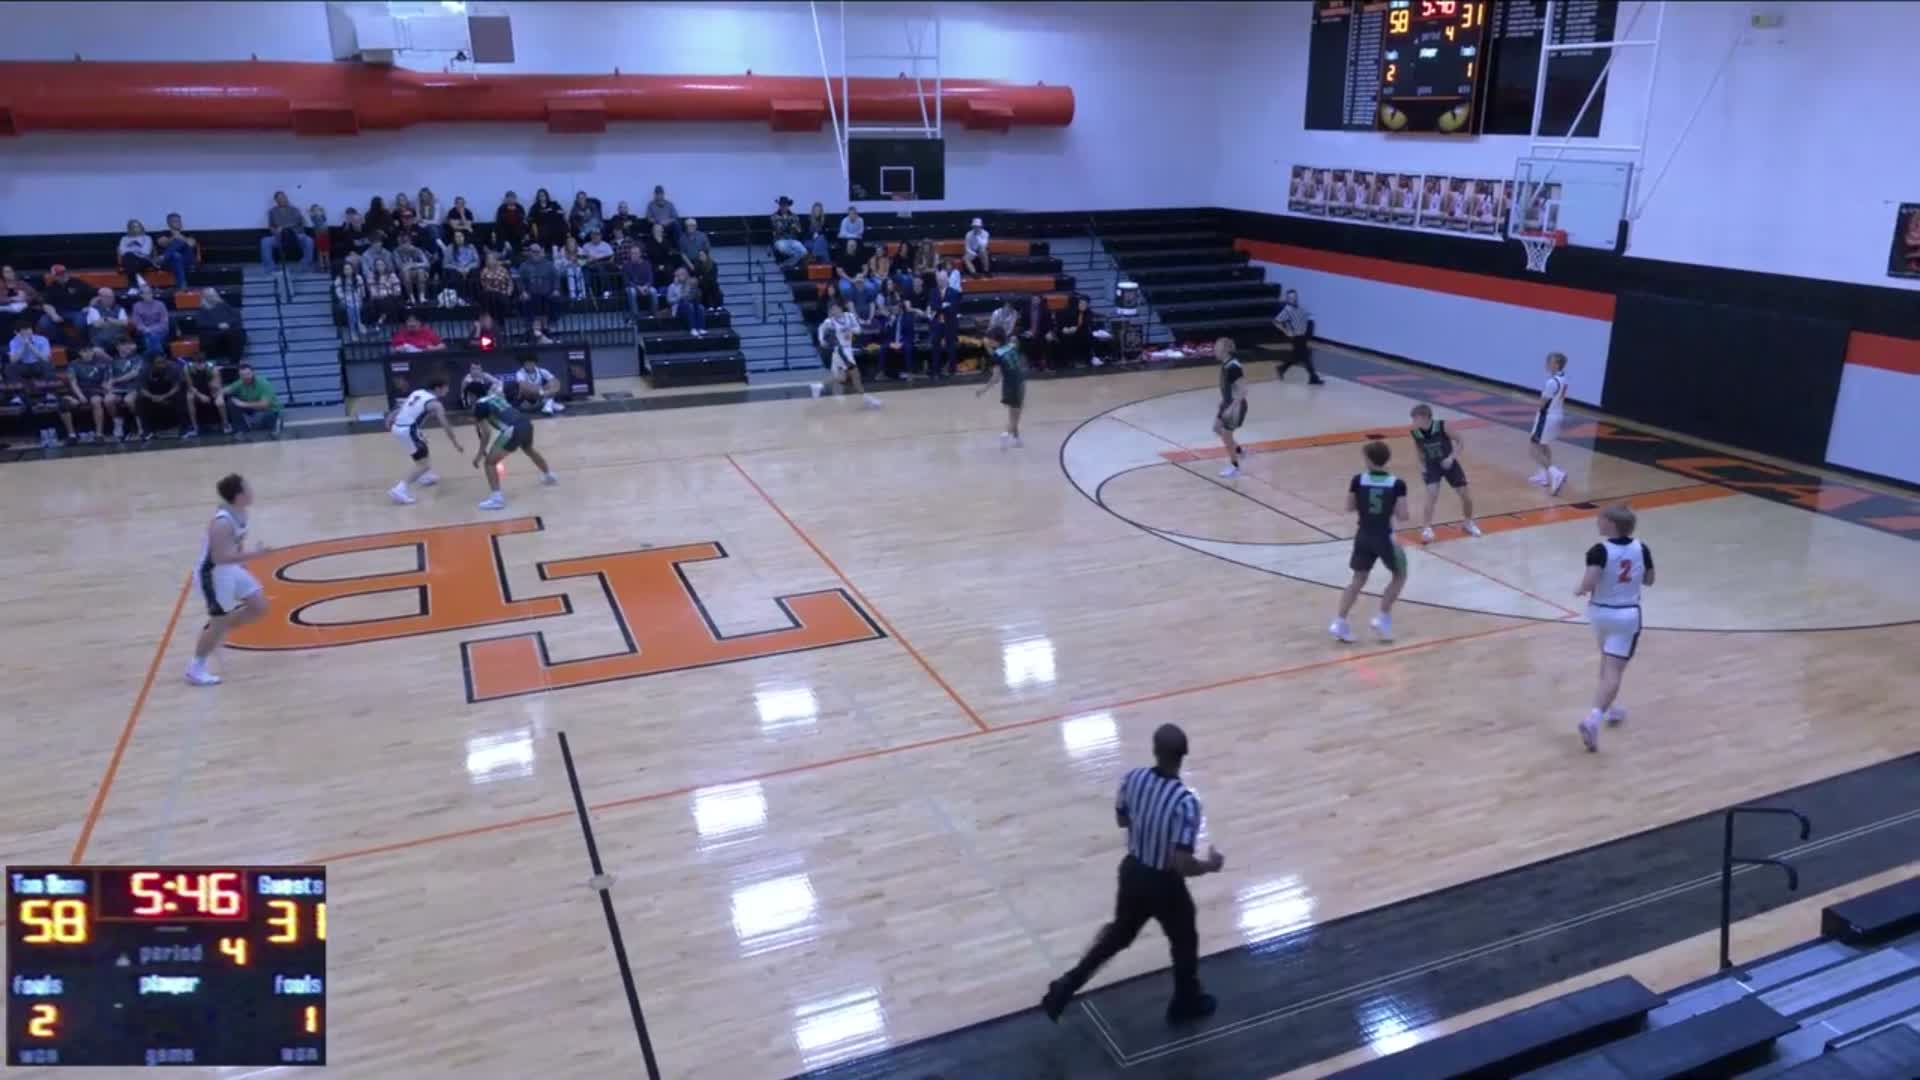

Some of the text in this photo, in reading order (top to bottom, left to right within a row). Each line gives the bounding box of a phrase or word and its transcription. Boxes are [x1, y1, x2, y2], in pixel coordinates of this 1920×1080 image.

[1389, 9, 1409, 34] 58
[1460, 3, 1483, 28] 31
[1445, 25, 1455, 41] 4
[1386, 64, 1396, 81] 2
[1369, 487, 1384, 514] 5
[1616, 558, 1633, 584] 2
